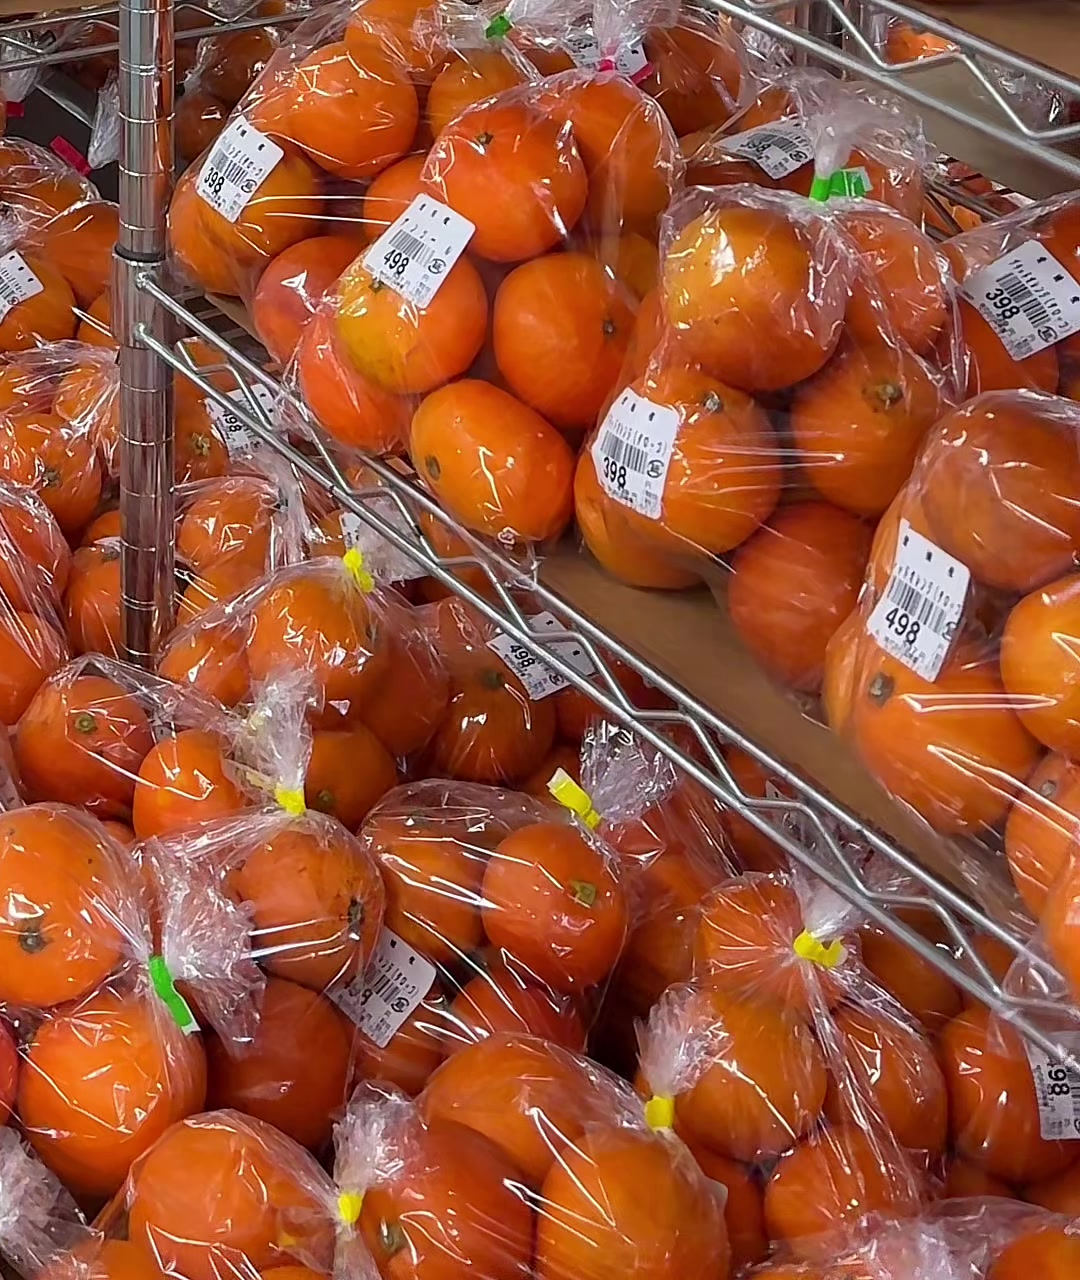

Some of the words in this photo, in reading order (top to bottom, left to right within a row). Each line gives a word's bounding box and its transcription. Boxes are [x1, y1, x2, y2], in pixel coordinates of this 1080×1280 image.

[204, 167, 224, 193] 398
[383, 248, 409, 275] 498
[985, 286, 1020, 320] 398
[603, 456, 628, 488] 398
[885, 608, 921, 645] 498
[510, 644, 536, 668] 498
